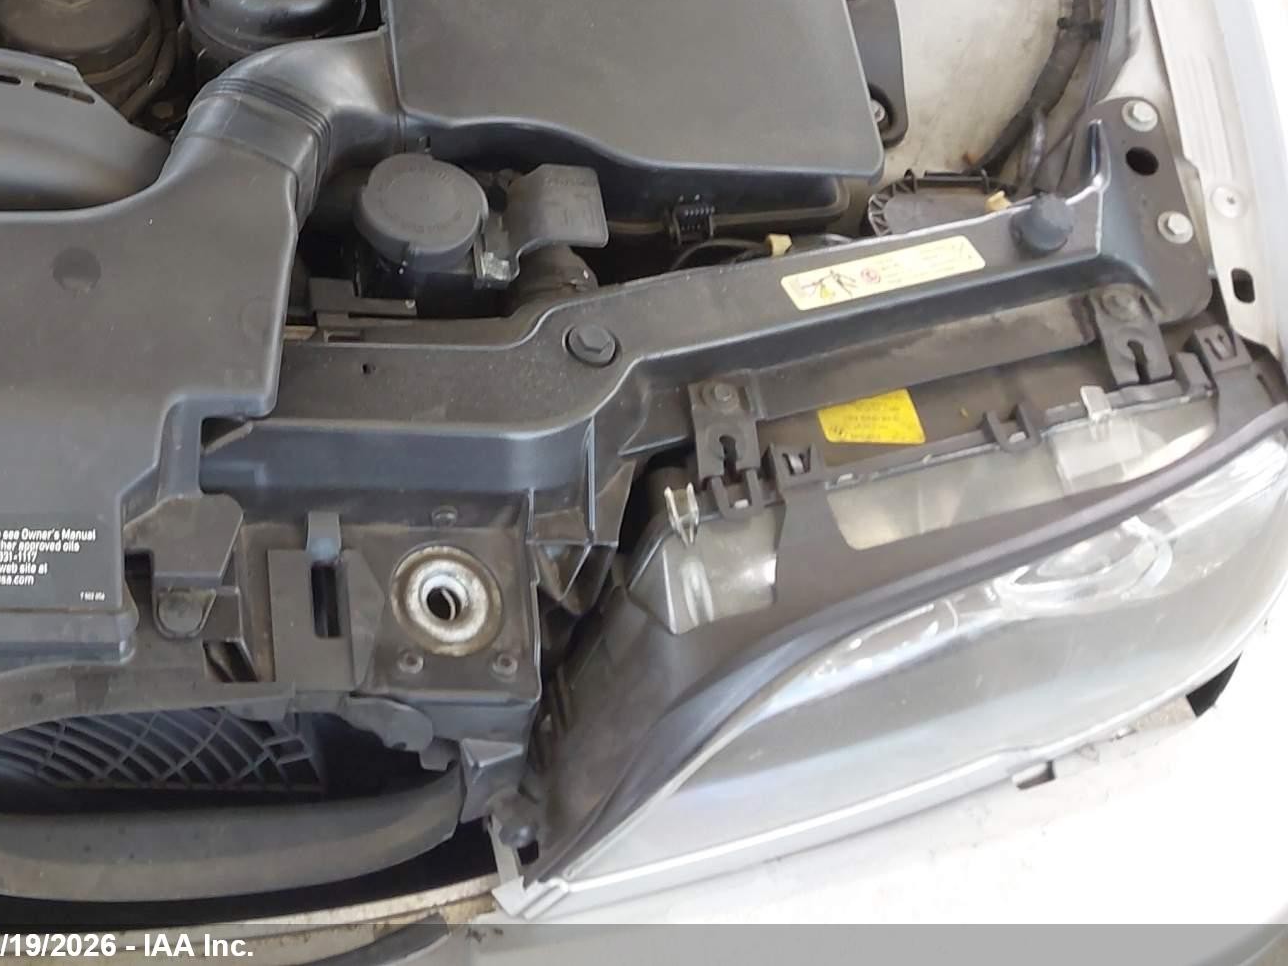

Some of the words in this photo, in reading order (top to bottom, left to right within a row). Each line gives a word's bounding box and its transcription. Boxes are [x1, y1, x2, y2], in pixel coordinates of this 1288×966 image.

[2, 530, 20, 540] see
[21, 528, 60, 540] Owner's
[62, 528, 96, 541] Manual
[18, 540, 61, 553] approved
[63, 541, 80, 552] oils
[19, 563, 37, 574] site
[38, 563, 48, 574] at
